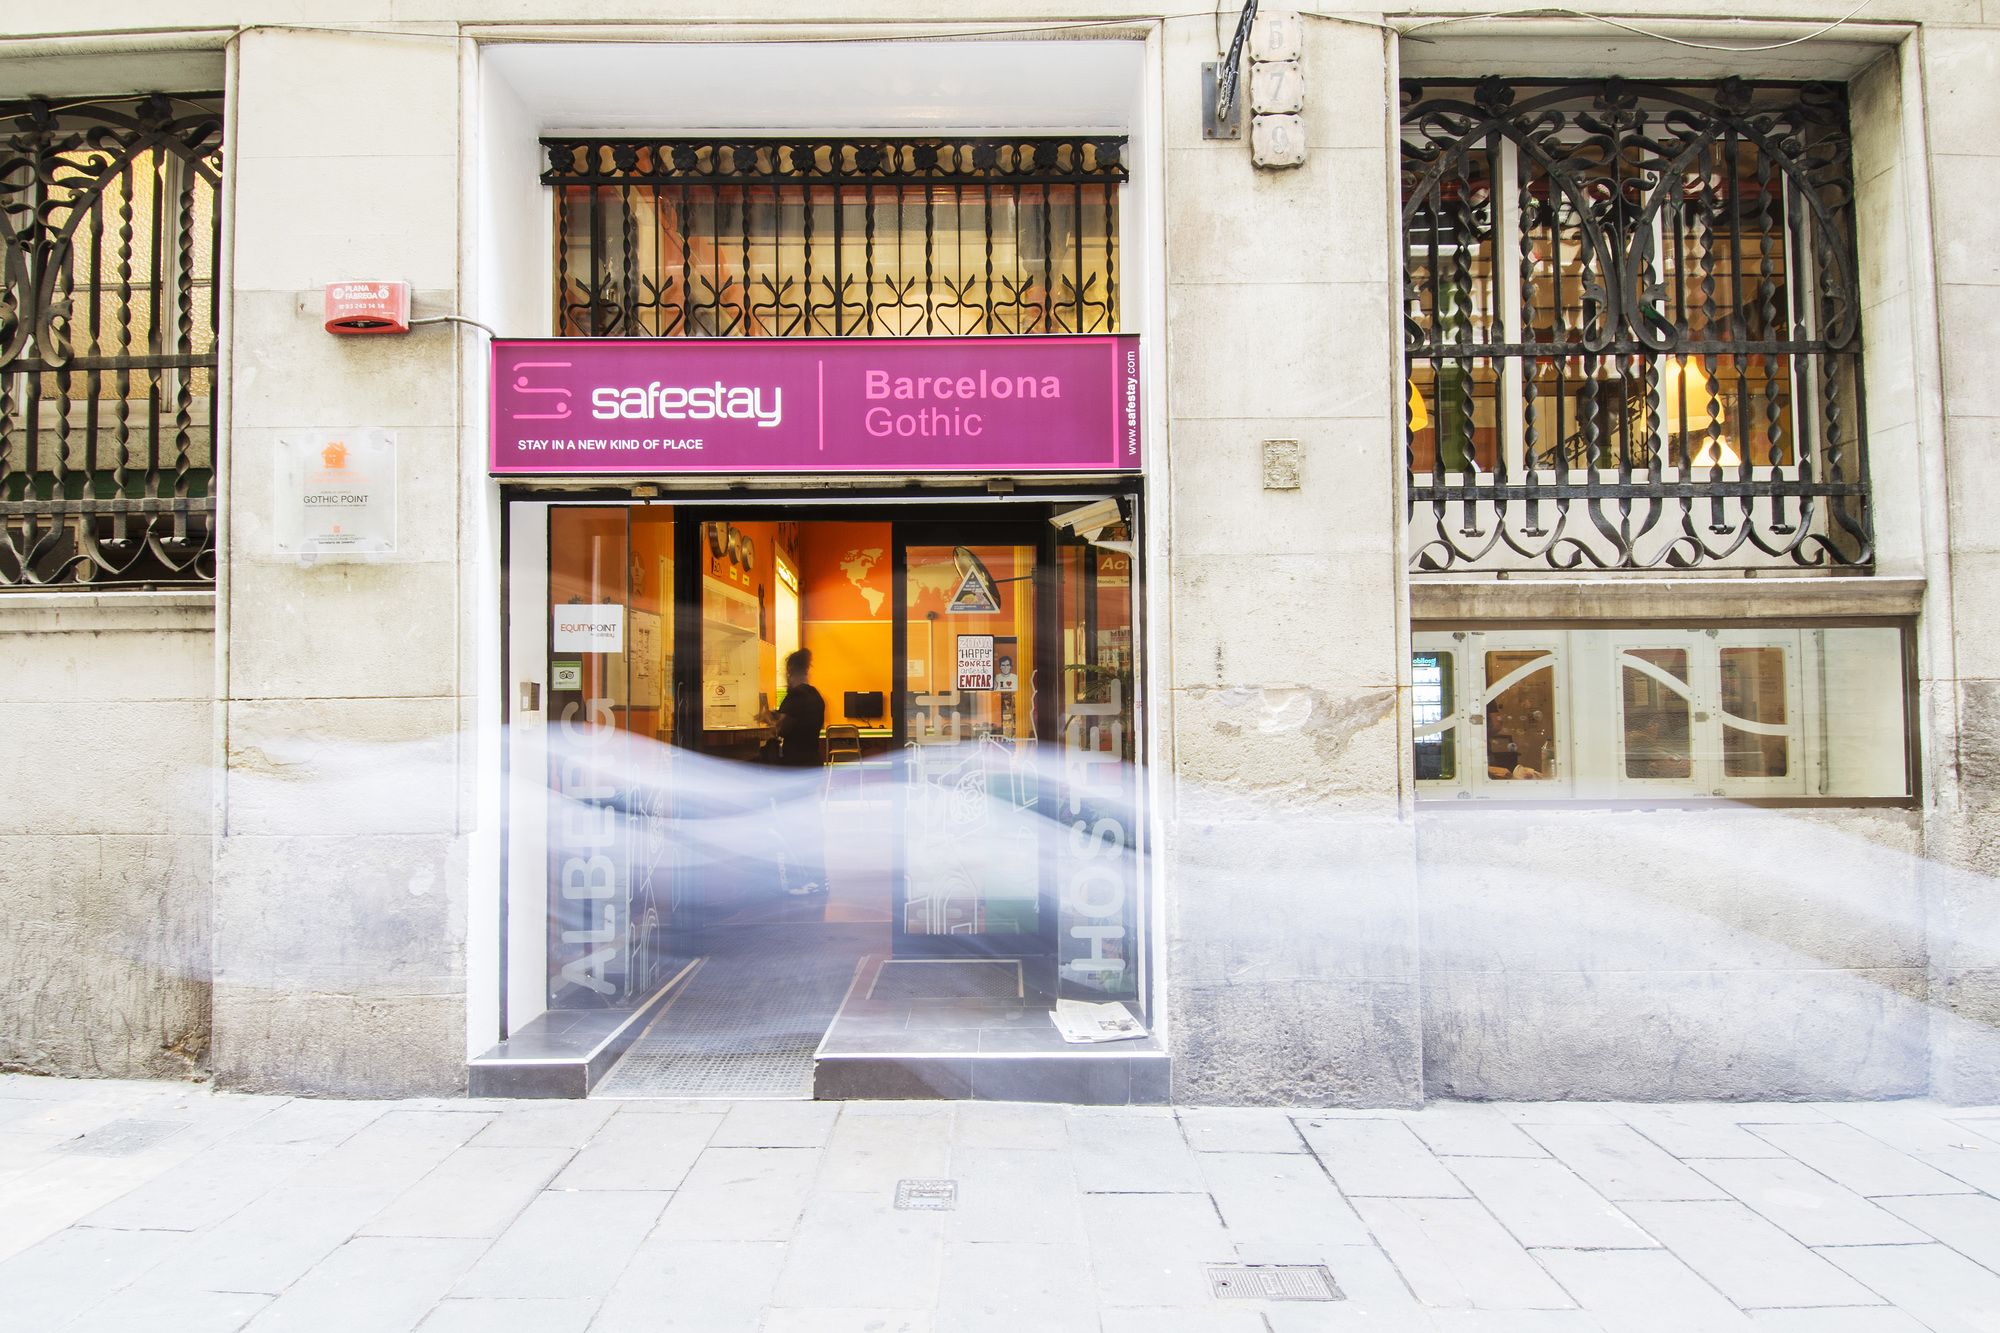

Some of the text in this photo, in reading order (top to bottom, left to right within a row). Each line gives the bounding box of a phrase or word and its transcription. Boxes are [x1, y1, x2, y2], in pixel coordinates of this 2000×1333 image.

[1270, 21, 1283, 49] 5
[1270, 73, 1284, 101] 7
[1272, 127, 1288, 154] 9
[865, 369, 1061, 399] Barcelona
[592, 381, 782, 428] safestay
[1126, 351, 1138, 456] www.safestay.com
[865, 406, 983, 437] Gothic
[518, 439, 703, 450] STAY IN A NEW KIND OF PLACE
[304, 495, 368, 504] GOTHIC POINT
[560, 624, 616, 632] EQUITYPOINT
[960, 675, 991, 687] ENTRAR
[1067, 678, 1126, 972] HOSTEL
[561, 698, 616, 995] ALBERG
